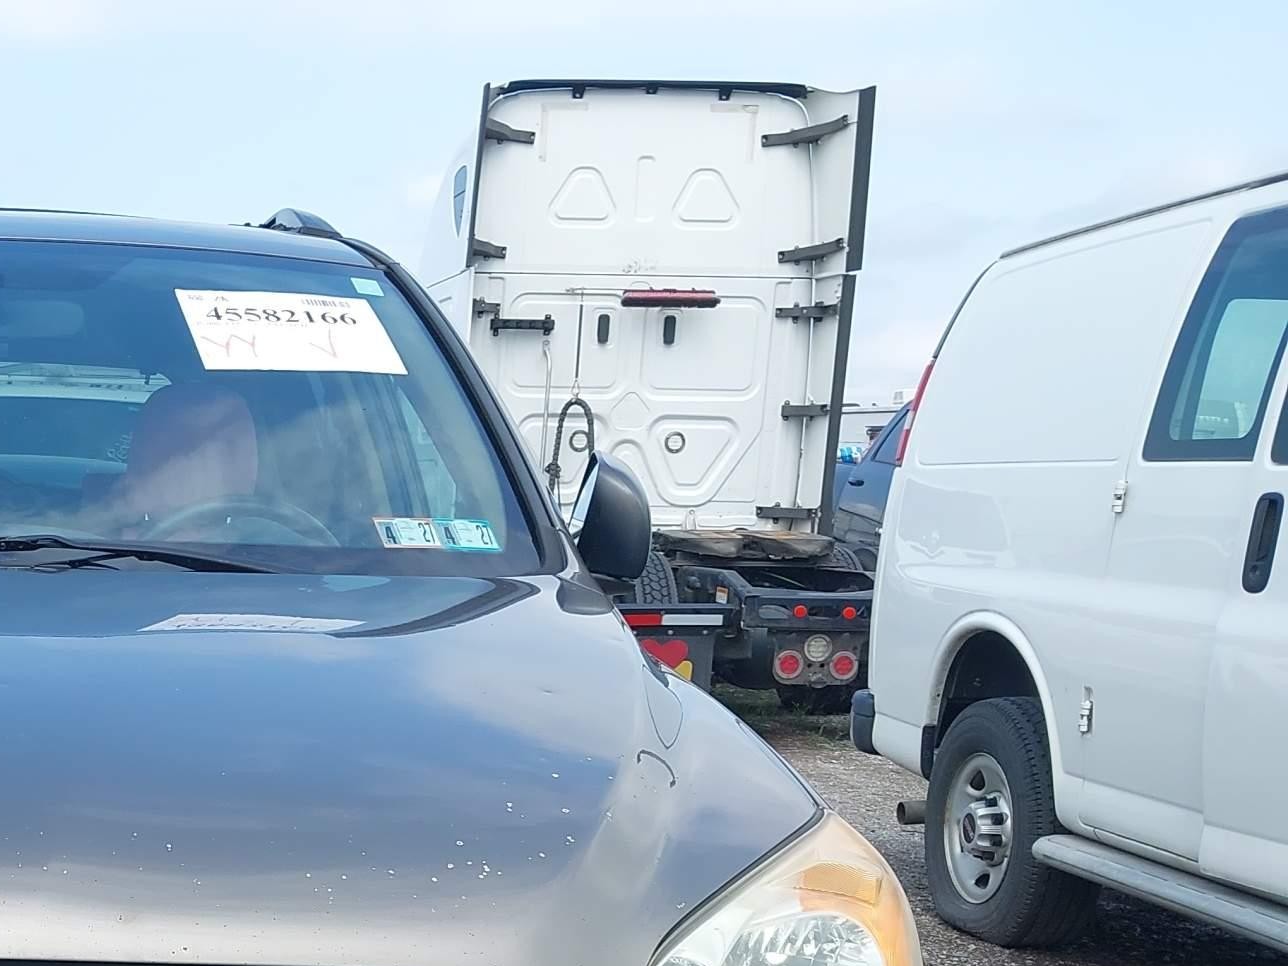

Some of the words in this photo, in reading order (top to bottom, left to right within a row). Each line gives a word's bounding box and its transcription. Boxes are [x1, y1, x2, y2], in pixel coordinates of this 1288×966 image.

[205, 306, 358, 326] 45582166
[384, 525, 399, 545] 4
[417, 522, 437, 545] 27
[443, 526, 458, 546] 4
[475, 524, 494, 546] 27
